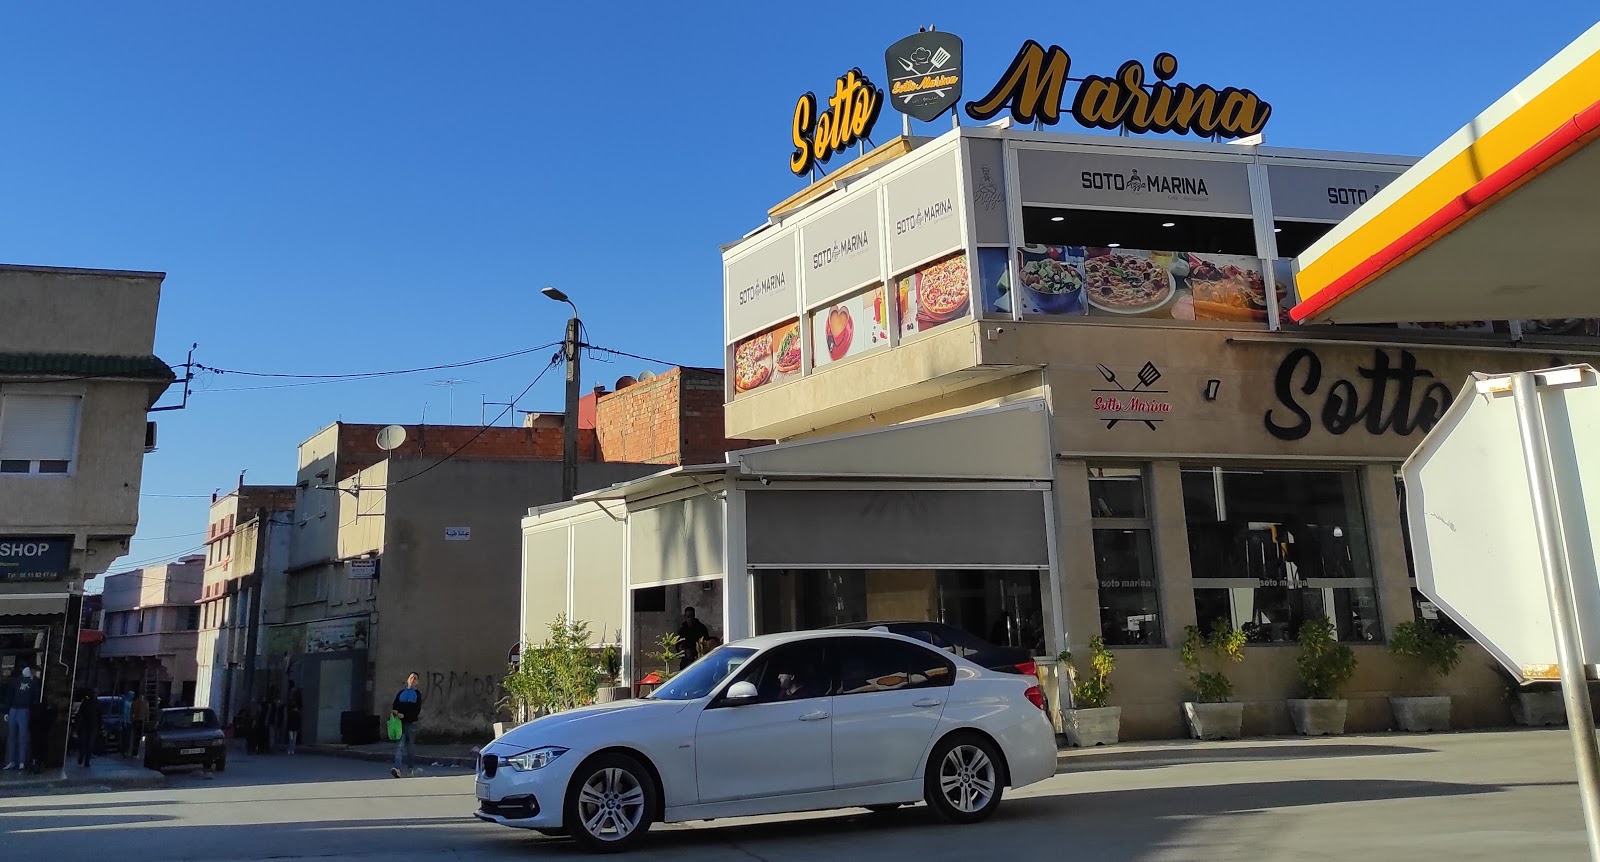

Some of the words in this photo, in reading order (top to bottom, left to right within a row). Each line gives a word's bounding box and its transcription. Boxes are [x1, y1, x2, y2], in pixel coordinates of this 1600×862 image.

[790, 67, 884, 177] Sotto
[965, 38, 1273, 138] Marina
[1081, 171, 1125, 191] SOTO
[1146, 175, 1209, 196] MARINA
[1327, 187, 1368, 205] SOTO
[896, 214, 916, 236] SOTO
[924, 197, 953, 223] MARINA
[813, 247, 832, 270] SOTO
[840, 230, 869, 257] MARINA
[739, 285, 755, 306] SOTO
[761, 271, 786, 295] MARINA
[1093, 395, 1123, 412] Sotto
[1124, 395, 1173, 413] Marina
[1263, 347, 1455, 441] Sotto
[0, 542, 50, 557] SHOP
[1101, 578, 1120, 588] soto
[1121, 578, 1152, 588] marina
[1260, 578, 1278, 587] soto
